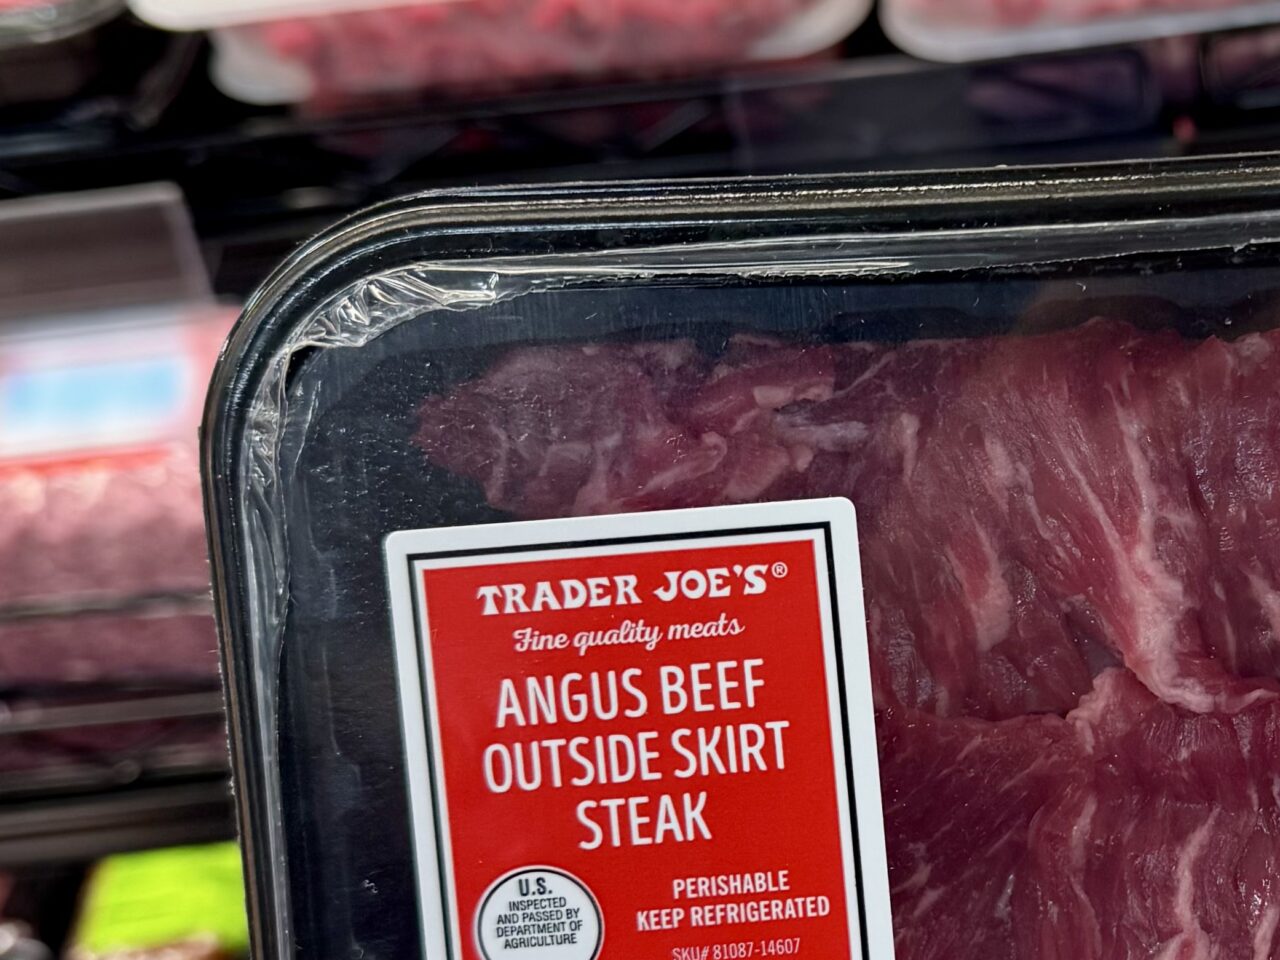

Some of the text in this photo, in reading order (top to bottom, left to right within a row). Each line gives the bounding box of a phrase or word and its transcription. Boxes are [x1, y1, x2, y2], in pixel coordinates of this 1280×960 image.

[476, 574, 643, 616] TRADER
[512, 612, 746, 656] Fine quality meats
[496, 658, 765, 728] ANGUS BEEF
[482, 721, 790, 793] OUTSIDE SKIRT
[576, 791, 712, 850] STEAK
[518, 877, 553, 897] U.S.
[672, 870, 790, 899] PERISHABLE
[497, 908, 580, 925] AND PASSED BY
[509, 897, 567, 912] INSPECTED
[636, 896, 830, 932] KEEP REFRIGERATED
[496, 920, 583, 938] DEPARTMENT OF
[504, 933, 577, 949] AGRICULTURE
[713, 937, 800, 960] 81087-14607
